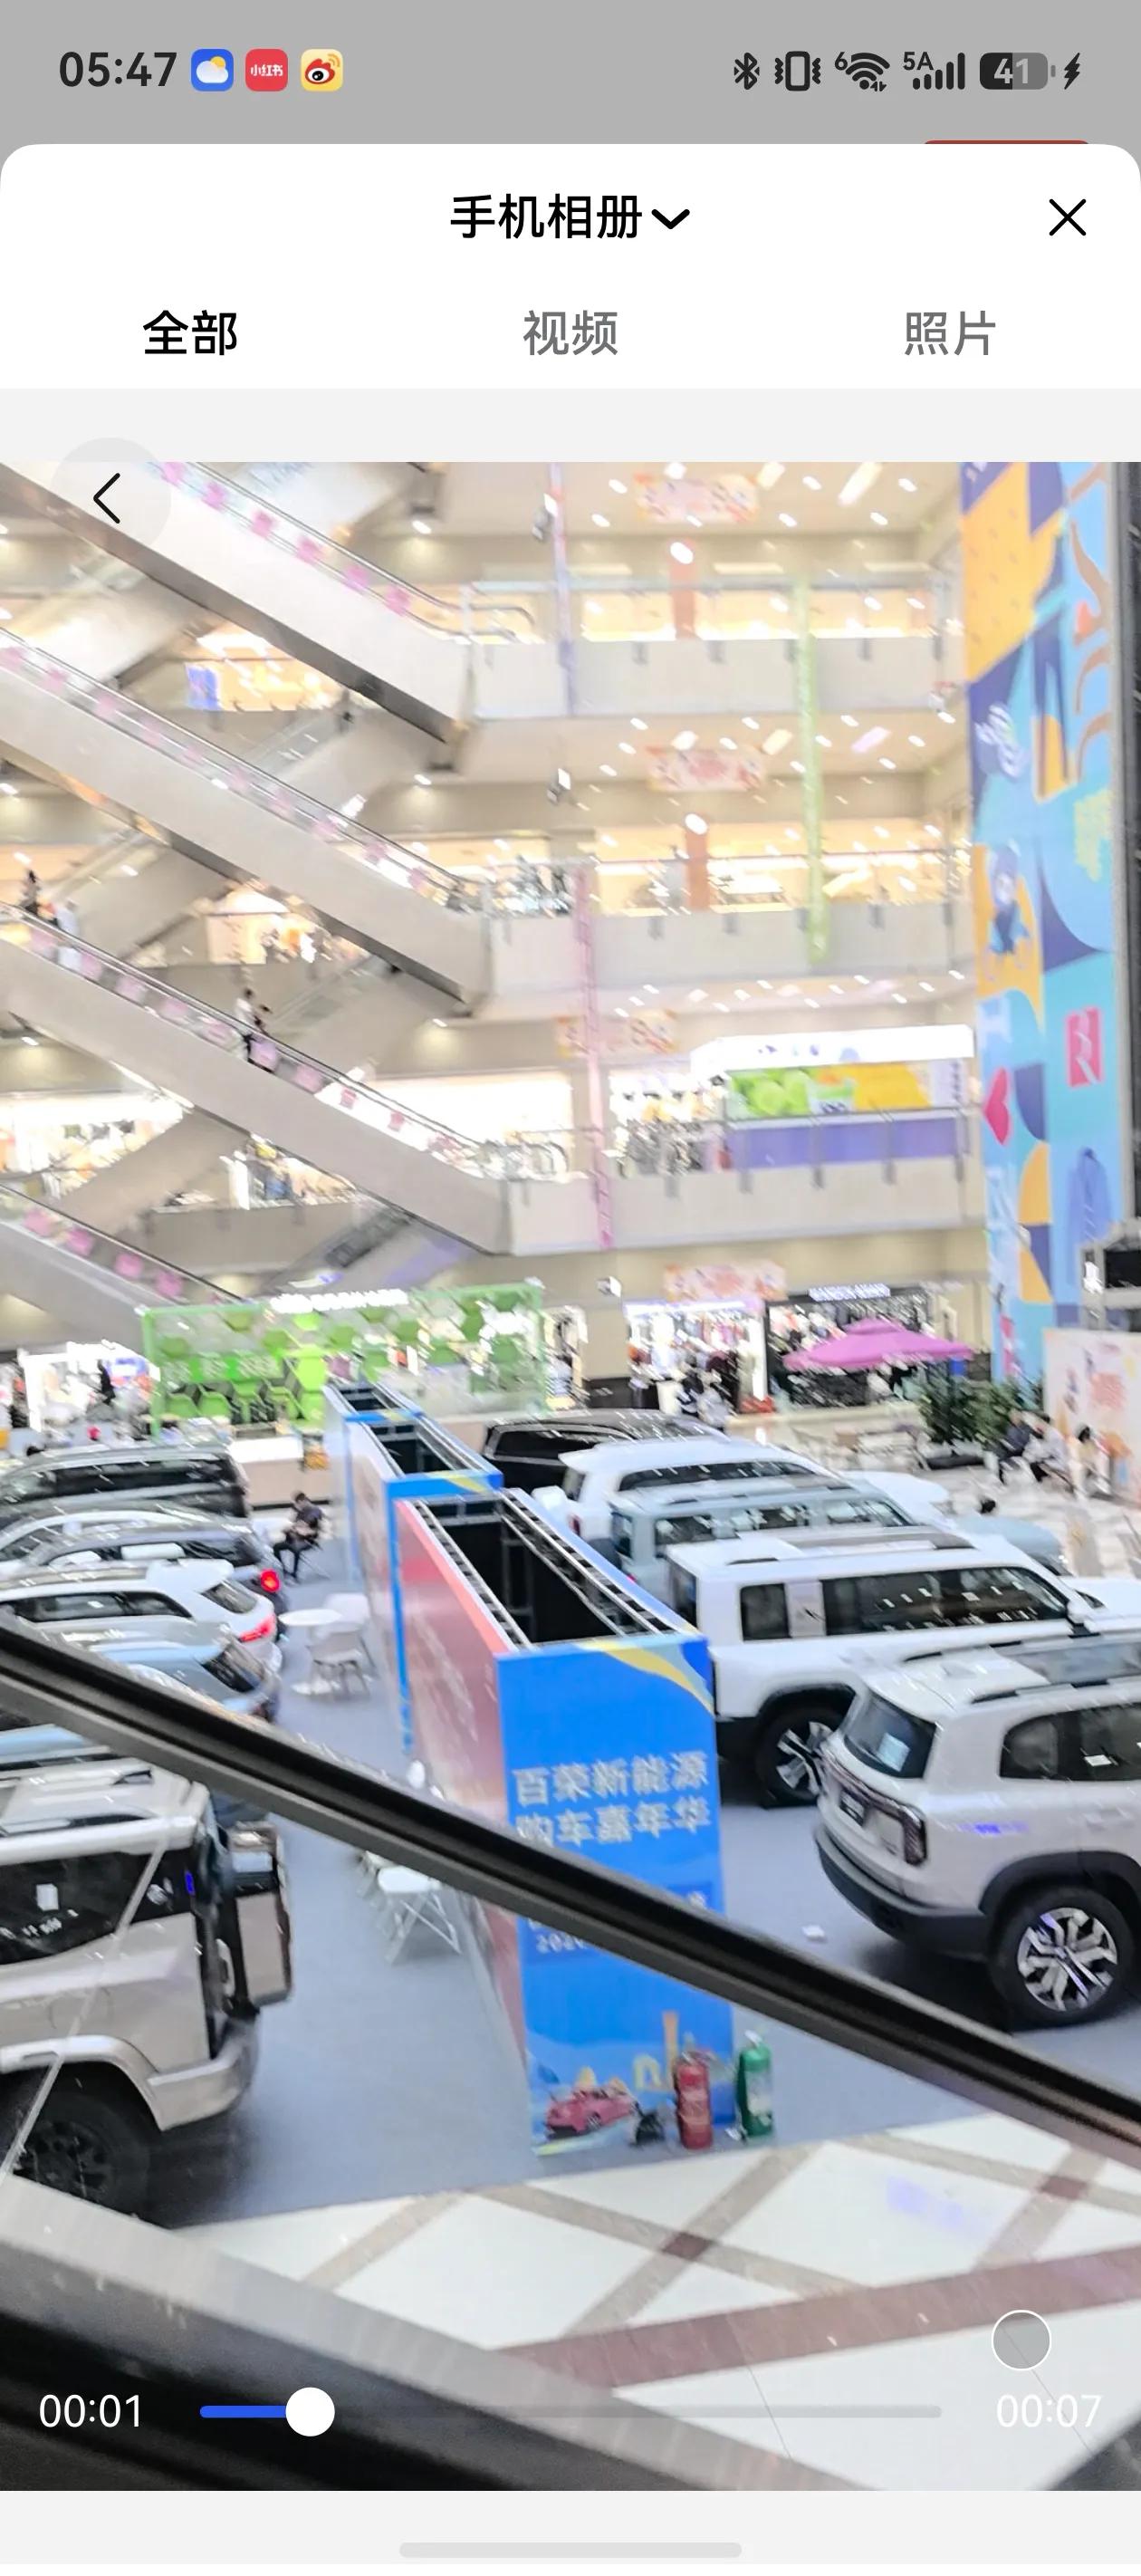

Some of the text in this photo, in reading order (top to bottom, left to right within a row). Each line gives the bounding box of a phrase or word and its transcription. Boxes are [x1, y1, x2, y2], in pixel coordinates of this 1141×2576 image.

[512, 1750, 709, 1808] 百荣新能源
[514, 1795, 711, 1849] 购车嘉年华
